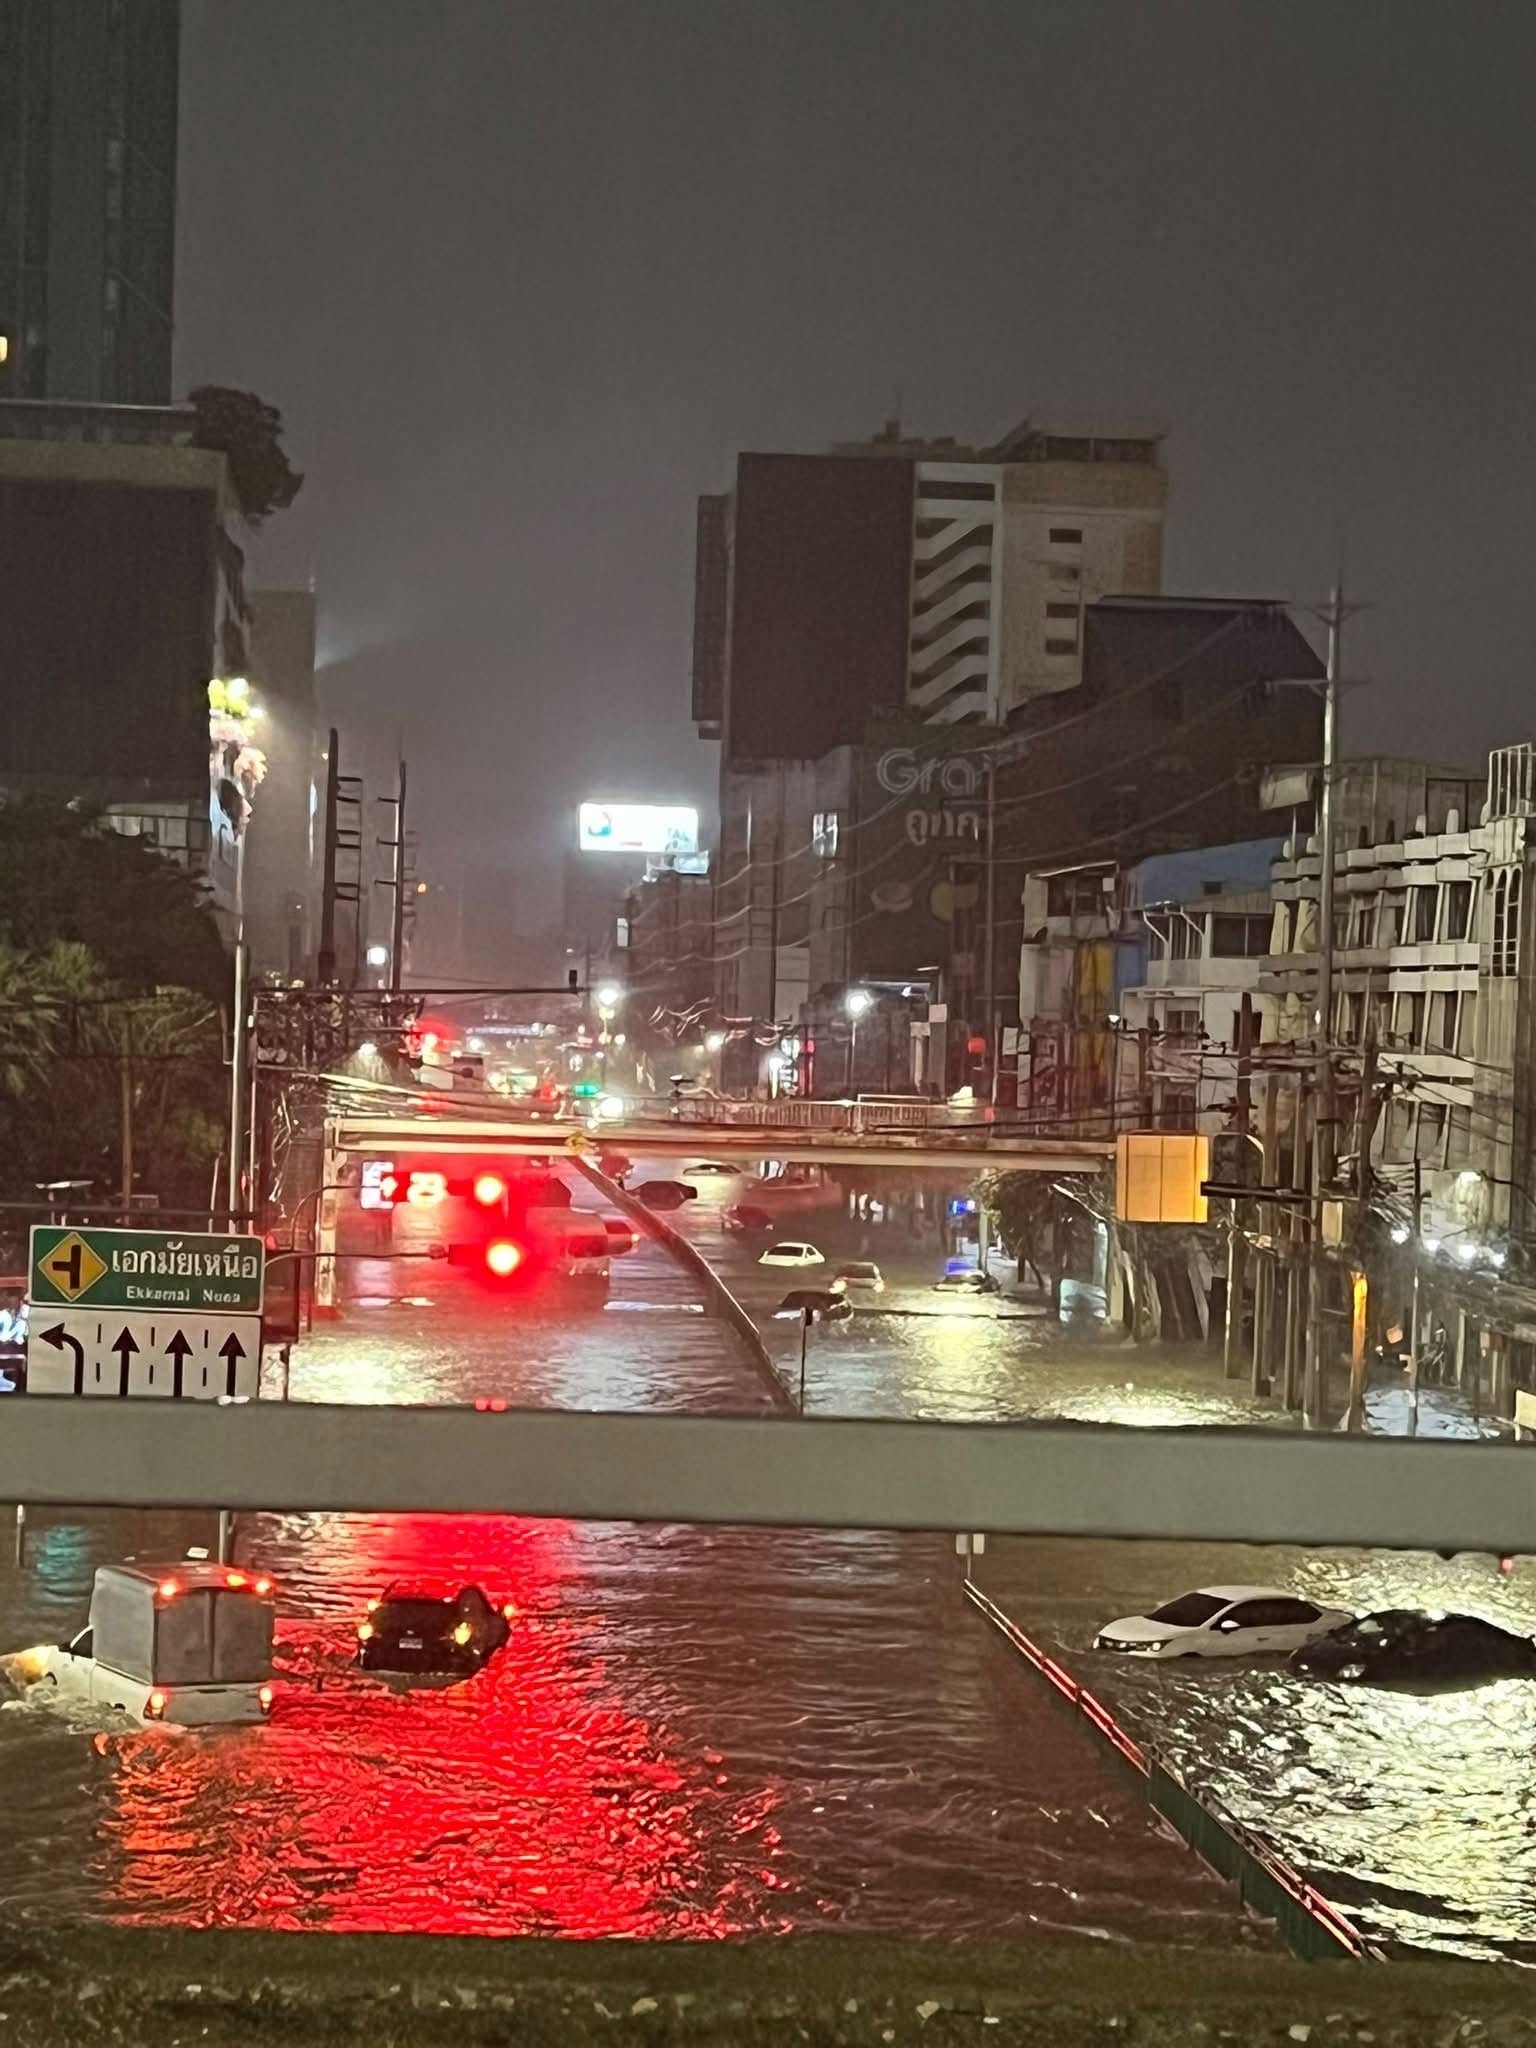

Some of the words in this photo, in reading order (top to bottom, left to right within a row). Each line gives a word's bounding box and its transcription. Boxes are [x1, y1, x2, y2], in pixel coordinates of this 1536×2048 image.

[112, 1241, 258, 1279] เอกมัยเหนือ
[126, 1285, 191, 1302] Ekkamai
[203, 1288, 241, 1304] Nuea
